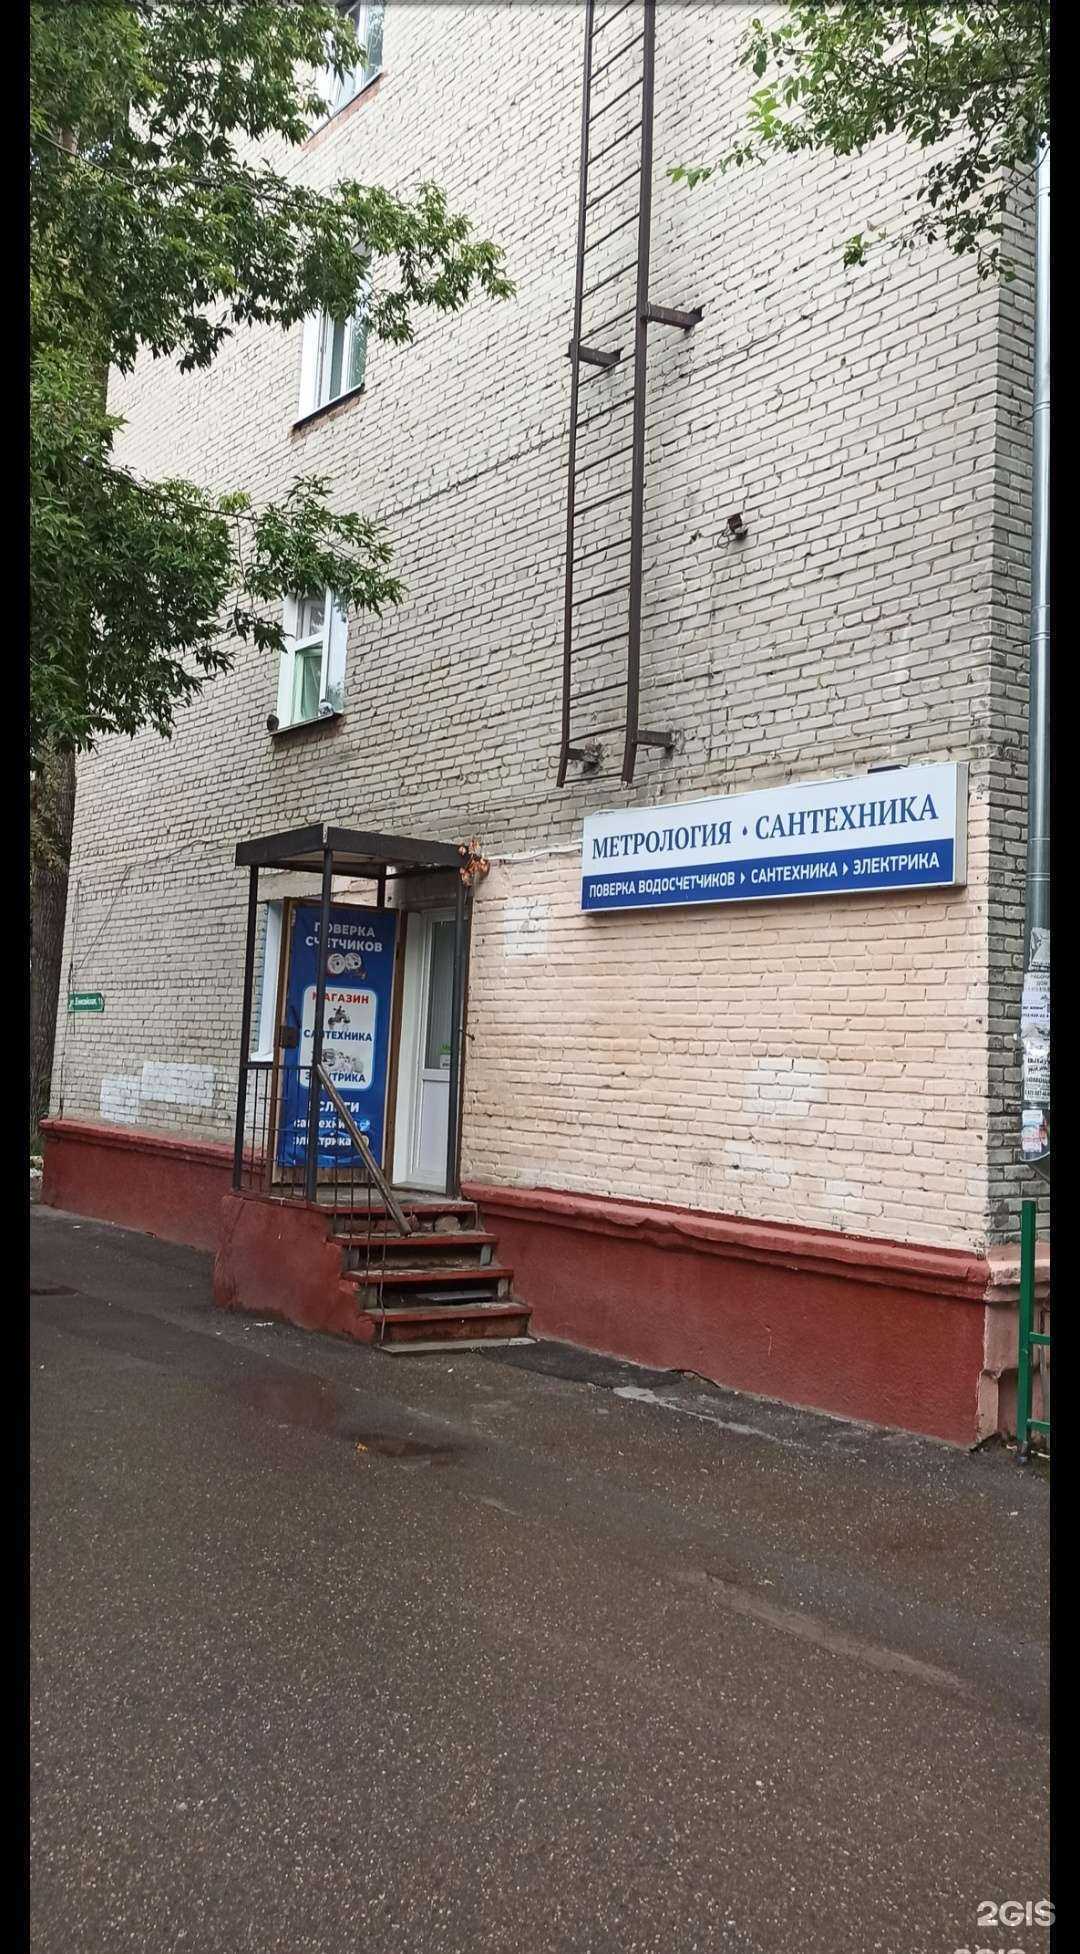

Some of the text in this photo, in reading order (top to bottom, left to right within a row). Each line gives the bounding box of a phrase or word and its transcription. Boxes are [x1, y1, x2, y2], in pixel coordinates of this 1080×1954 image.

[592, 793, 939, 860] МЕТРОЛОГИЯ САНТЕХНИКА
[589, 851, 940, 898] ПОВЕРКА ВОДОСЧЕТЧИКОВ САНТЕХНИКА ЭЛЕКТРИКА
[305, 936, 383, 953] СЧТЧИКОВ
